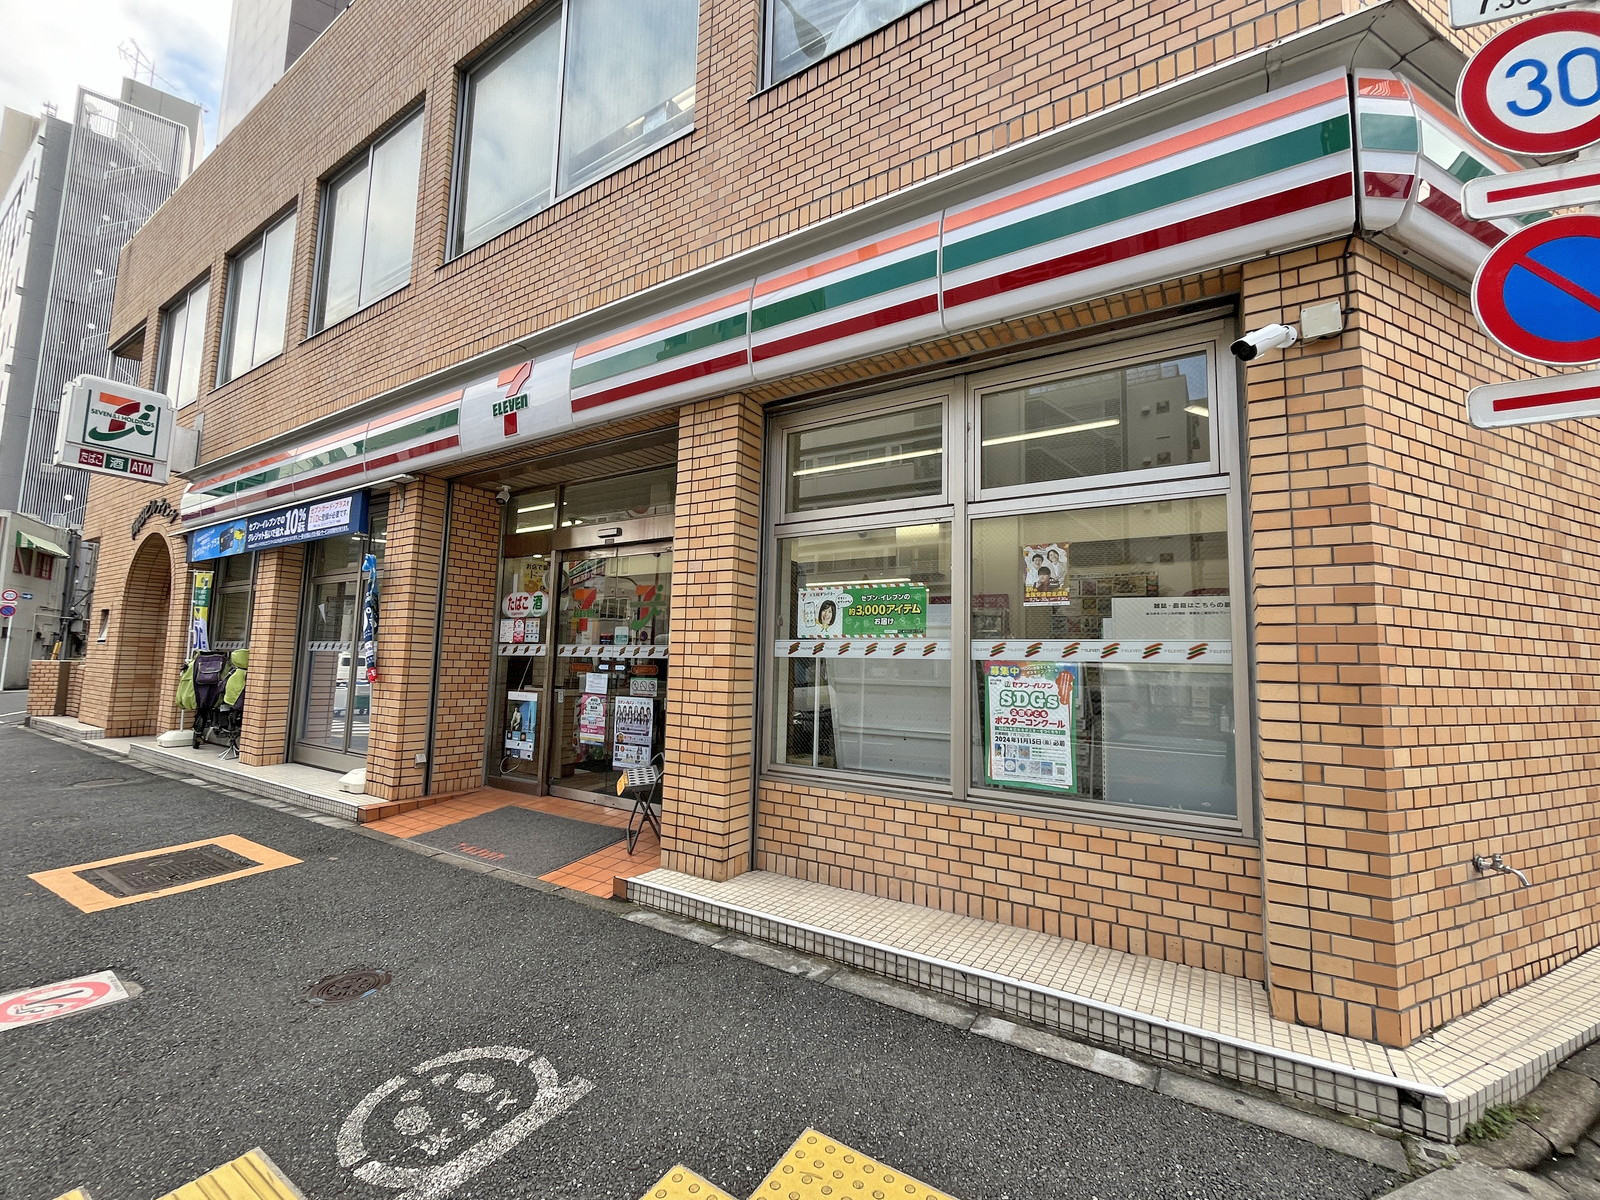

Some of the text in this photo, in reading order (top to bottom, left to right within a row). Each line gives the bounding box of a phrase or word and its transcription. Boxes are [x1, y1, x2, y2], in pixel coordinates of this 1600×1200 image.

[1505, 47, 1600, 117] 30
[121, 415, 155, 428] HOLDINGS
[80, 451, 103, 465] たばこ
[110, 457, 123, 469] 酒
[131, 462, 152, 475] ATM
[507, 596, 529, 611] たばこ
[533, 595, 543, 611] 酒
[873, 617, 895, 626] お届け
[990, 665, 1020, 677] 募集中
[1000, 690, 1059, 709] SDGs
[995, 716, 1065, 728] ポスターコンクール
